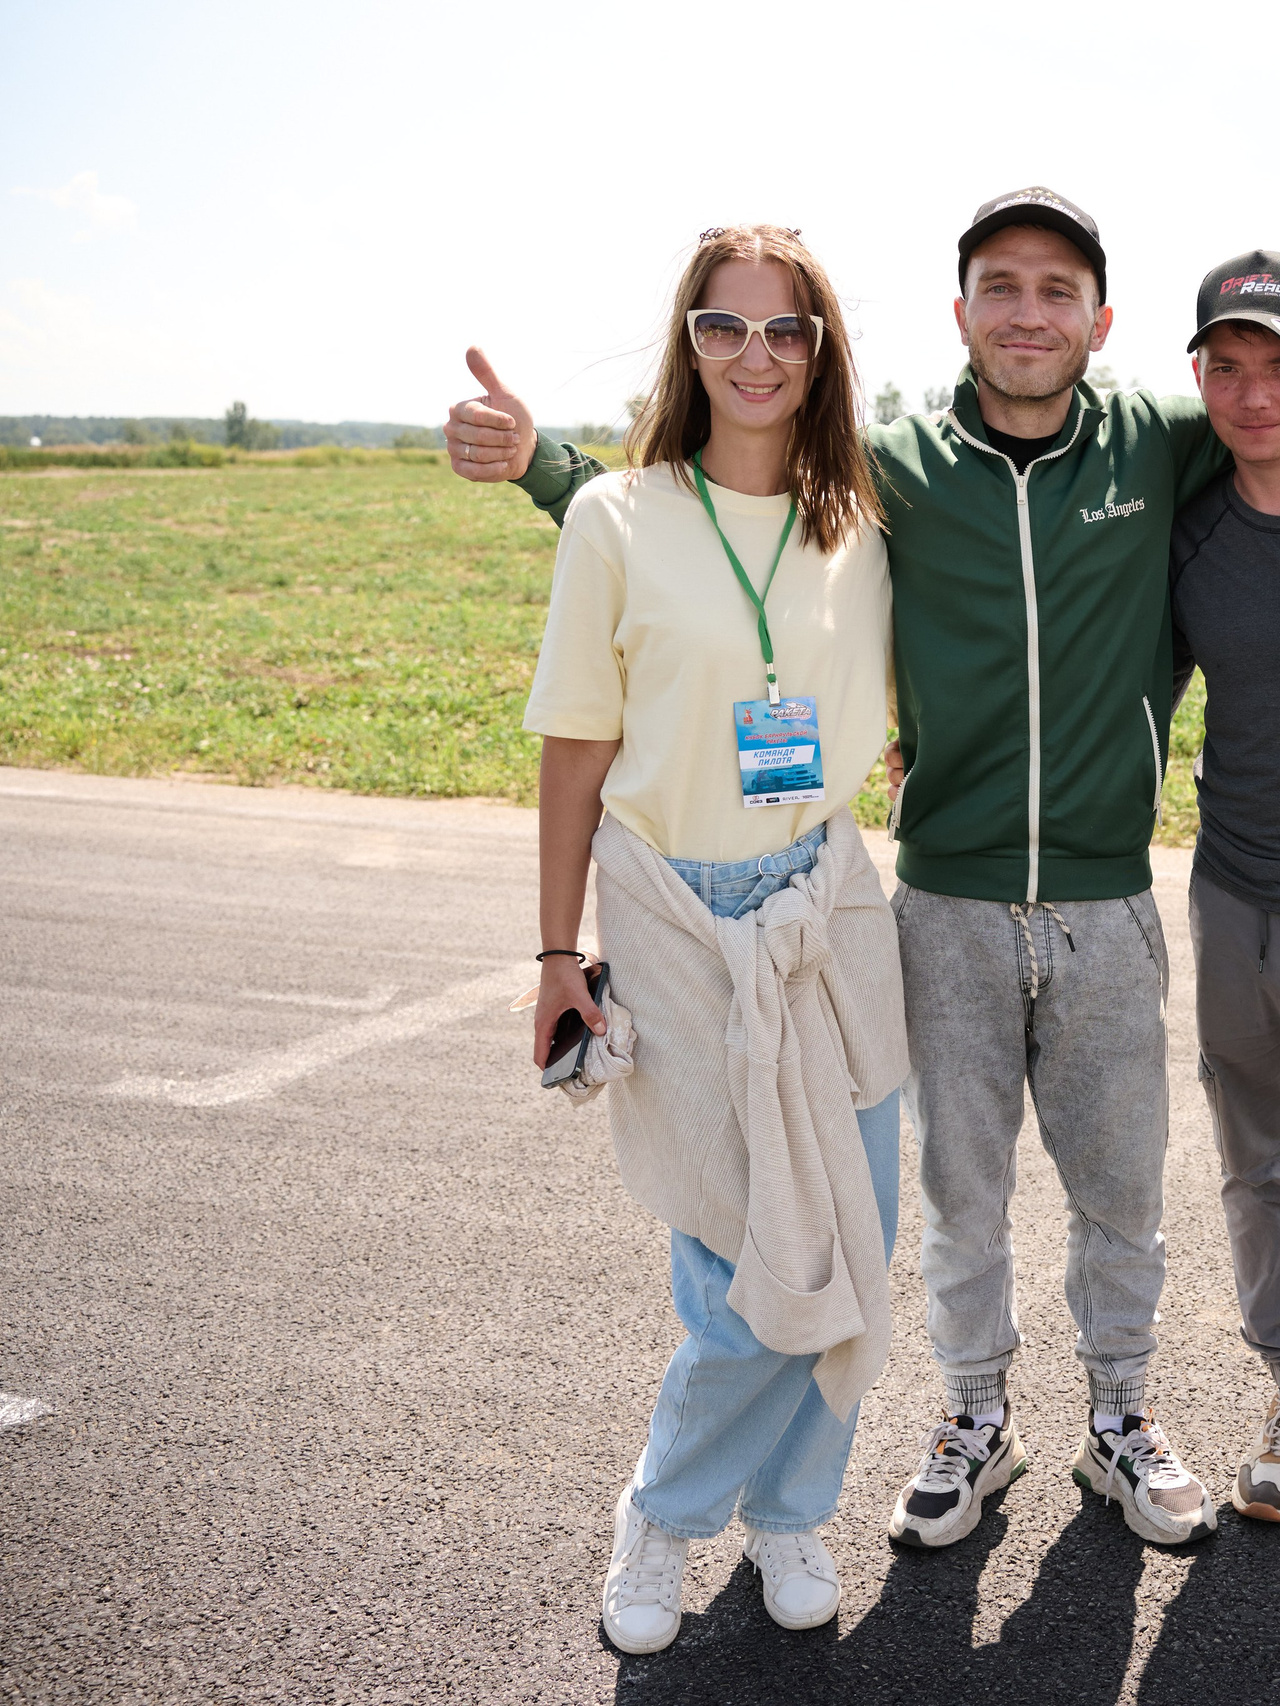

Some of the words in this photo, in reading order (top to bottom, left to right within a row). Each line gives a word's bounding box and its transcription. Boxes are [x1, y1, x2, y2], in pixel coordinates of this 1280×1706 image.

[1079, 507, 1105, 524] Los
[1105, 497, 1145, 518] Angeles
[753, 748, 796, 759] КОМАНДА
[758, 756, 792, 767] ПИЛОТА
